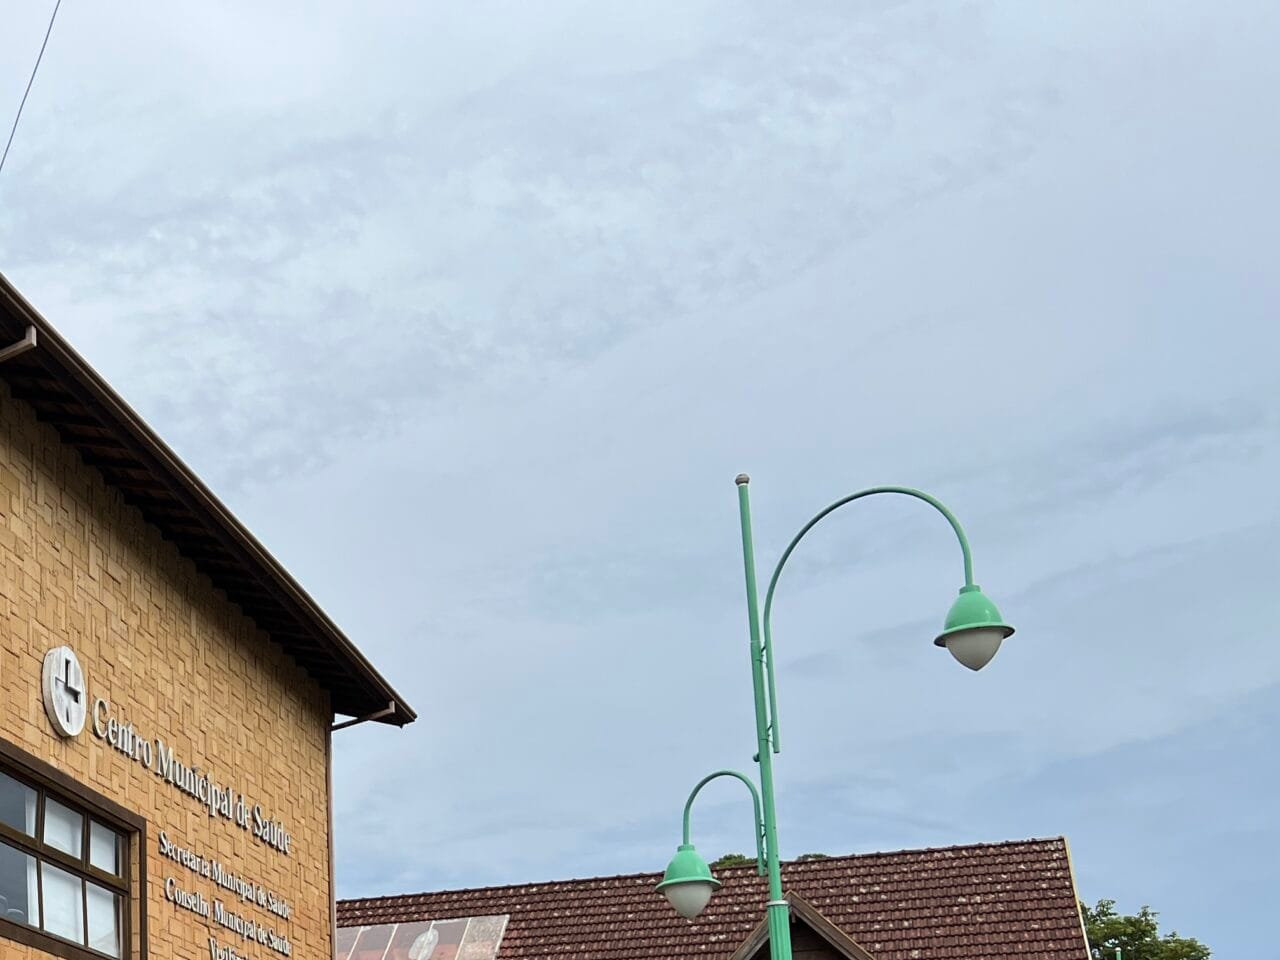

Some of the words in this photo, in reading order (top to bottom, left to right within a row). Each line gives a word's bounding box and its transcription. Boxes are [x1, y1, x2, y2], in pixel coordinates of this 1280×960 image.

[93, 698, 152, 768] Centro
[155, 739, 234, 821] Municipal
[237, 795, 251, 830] de
[252, 805, 292, 855] Saúde
[159, 832, 210, 876] Secretaria
[211, 862, 256, 901] Municipal
[256, 885, 267, 906] de
[267, 891, 292, 920] Saúde
[165, 877, 210, 918] Conselho
[214, 901, 256, 942] Municipal
[257, 924, 267, 946] de
[267, 928, 292, 957] Saúde
